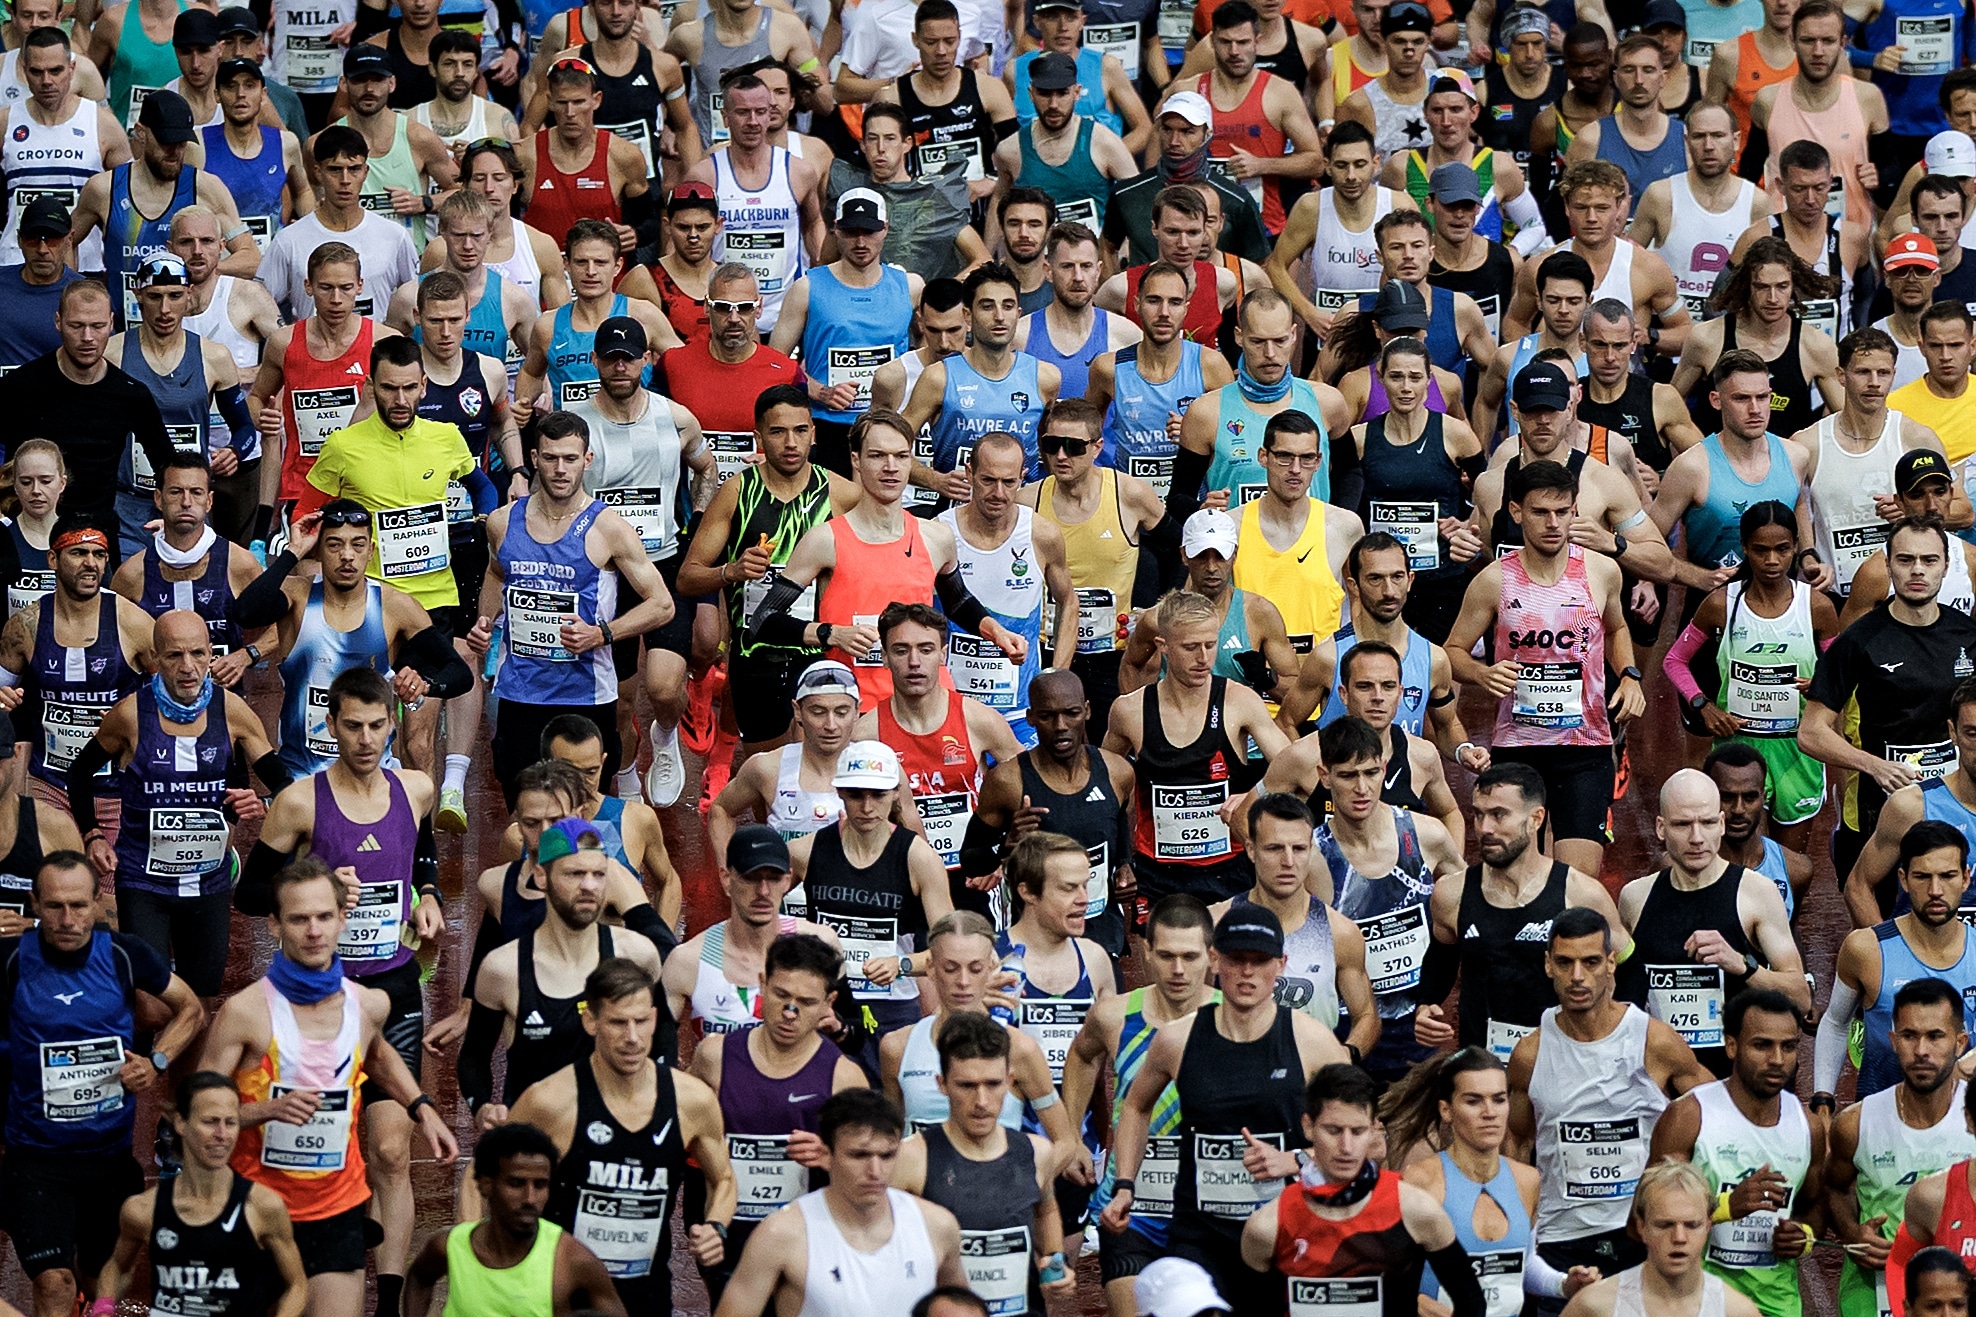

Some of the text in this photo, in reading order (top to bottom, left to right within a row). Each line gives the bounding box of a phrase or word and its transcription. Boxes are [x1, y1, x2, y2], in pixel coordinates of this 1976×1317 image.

[287, 10, 340, 25] MILA
[17, 149, 84, 161] CROYDON
[719, 208, 789, 222] BLACKBURN
[730, 235, 751, 248] tcs
[740, 252, 775, 260] ASHLEY
[1321, 292, 1342, 306] tcs
[555, 352, 593, 368] SPA
[834, 352, 857, 367] tcs
[566, 386, 587, 400] tcs
[297, 395, 319, 409] tcs
[316, 411, 340, 420] AXEL
[956, 417, 1031, 434] HAVRE.A.C
[917, 440, 933, 456] tc
[712, 455, 742, 463] ABIEN
[1135, 460, 1157, 476] tcs
[383, 512, 407, 528] tcs
[615, 509, 658, 518] ILLAUME
[1376, 506, 1397, 521] tcs
[393, 527, 438, 541] RAPHAEL
[1387, 526, 1421, 535] INGRID
[1838, 531, 1862, 547] tcs
[405, 545, 430, 559] 609
[386, 561, 428, 575] AMSTERDAM
[510, 561, 575, 579] BEDFORD
[513, 592, 536, 609] tcs
[524, 613, 563, 625] SAMUEL
[530, 632, 555, 644] 580
[955, 638, 977, 656] tcs
[965, 660, 1003, 670] DAVIDE
[1735, 662, 1757, 681] tcs
[970, 678, 994, 689] 541
[1527, 684, 1572, 694] THOMAS
[61, 689, 119, 702] MEUTE
[313, 688, 330, 705] tc
[1737, 686, 1790, 702] DOS SANTOS
[48, 704, 71, 723] tcs
[1536, 702, 1563, 713] 638
[1751, 702, 1772, 713] LIMA
[847, 760, 883, 772] HOKA
[1917, 767, 1946, 779] NTON
[144, 778, 226, 794] LA MEUTE
[1159, 789, 1184, 807] tcs
[157, 812, 183, 829] tcs
[1173, 810, 1215, 820] KIERAN
[922, 819, 953, 830] HUGO
[160, 833, 222, 843] MUSTAPHA
[1181, 828, 1210, 840] 626
[175, 850, 203, 861] 503
[1160, 844, 1206, 855] AMSTERDAM
[151, 861, 197, 873] AMSTERDAM
[811, 885, 904, 910] HIGHGATE
[344, 909, 391, 919] ORENZO
[350, 928, 380, 941] 397
[1360, 925, 1381, 941] cs
[1369, 933, 1418, 954] MATHIJS
[1383, 956, 1413, 973] 370
[1650, 970, 1674, 988] tcs
[1670, 994, 1698, 1003] KARI
[1027, 1004, 1053, 1023] tcs
[1670, 1014, 1700, 1027] 476
[49, 1047, 77, 1066] tcs
[58, 1067, 114, 1080] ANTHONY
[73, 1086, 102, 1101] 695
[1564, 1122, 1593, 1141] tcs
[294, 1136, 325, 1149] 650
[732, 1138, 756, 1159] tcs
[1202, 1139, 1231, 1159] tcs
[1585, 1146, 1622, 1156] SELMI
[587, 1160, 669, 1190] MILA
[748, 1165, 784, 1176] EMILE
[1590, 1166, 1621, 1179] 606
[1142, 1171, 1179, 1185] PETER
[751, 1186, 783, 1199] 427
[586, 1194, 618, 1217] tcs
[960, 1238, 983, 1256] cs
[156, 1264, 240, 1290] MILA
[1296, 1281, 1328, 1303] tcs
